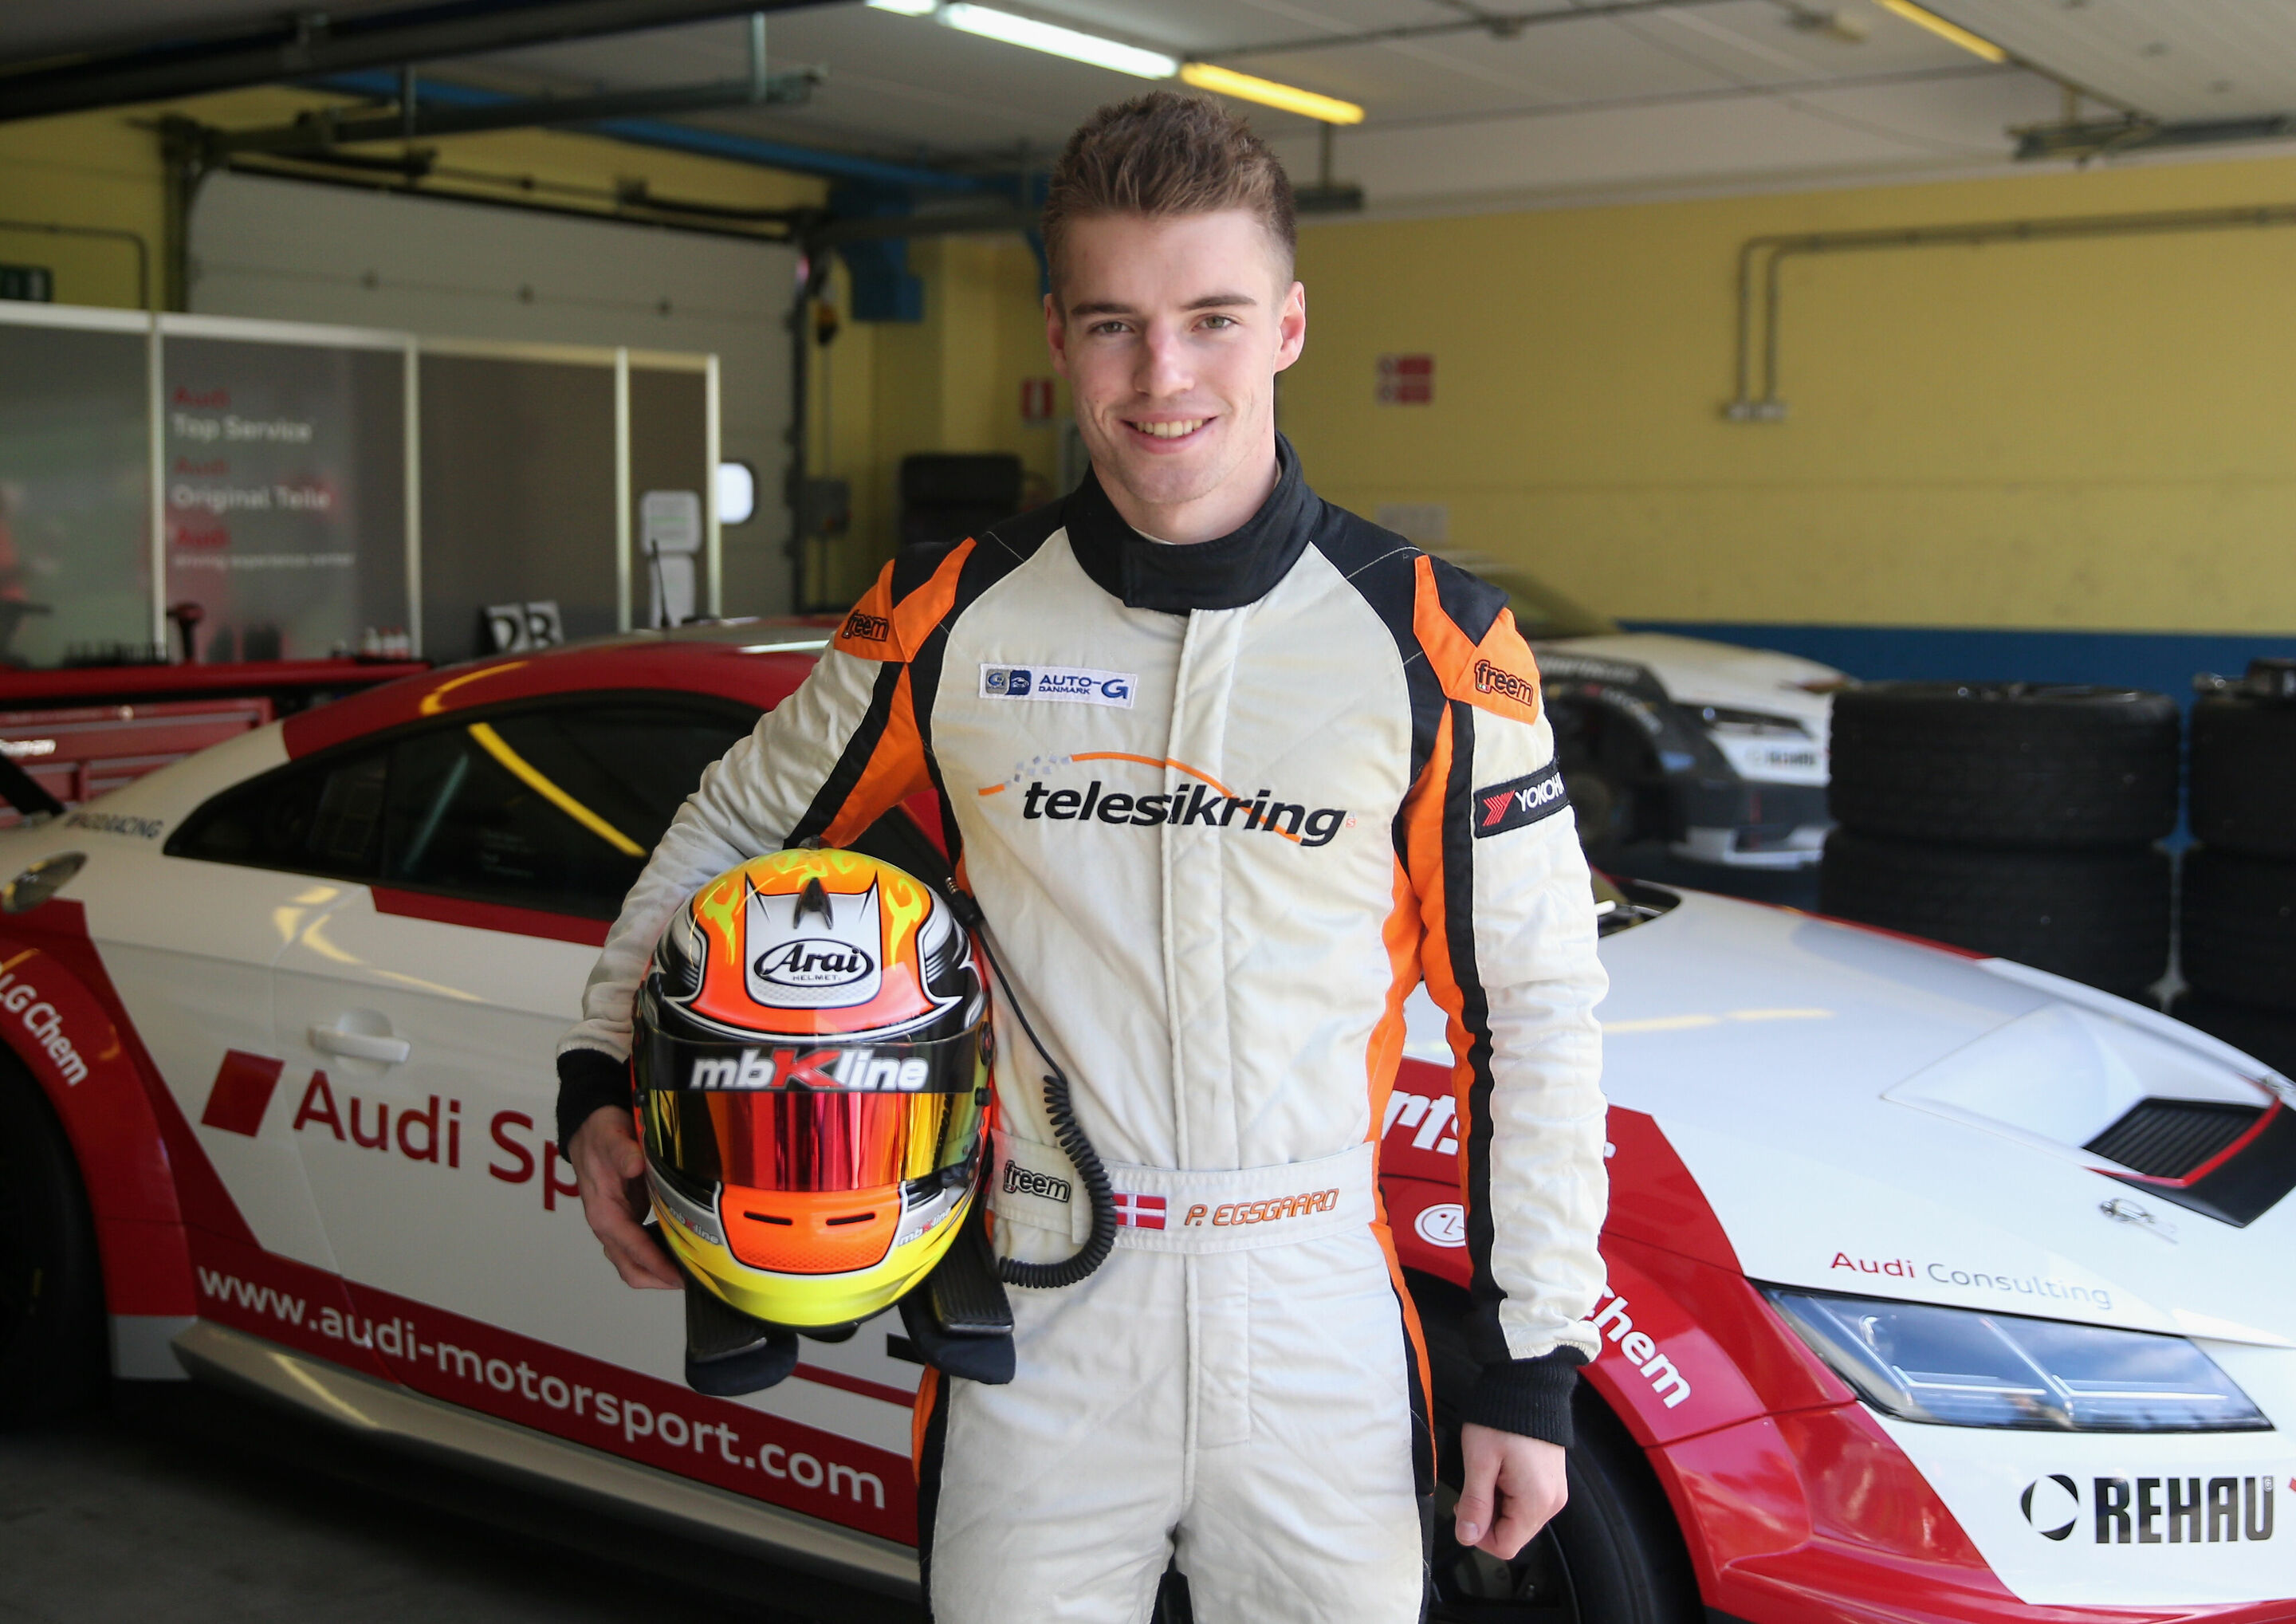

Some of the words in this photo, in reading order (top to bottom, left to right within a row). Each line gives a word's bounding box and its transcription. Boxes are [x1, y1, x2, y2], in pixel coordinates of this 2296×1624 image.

[171, 412, 221, 442] Top
[222, 413, 313, 443] Service
[171, 483, 269, 514] Original
[843, 610, 888, 641] freem
[1475, 660, 1533, 706] freem
[1023, 781, 1346, 847] telesikring
[762, 942, 861, 975] Arai
[22, 1001, 88, 1087] Chem
[689, 1048, 930, 1090] mbKline
[293, 1068, 461, 1169] Audi
[1004, 1159, 1071, 1202] freem
[1185, 1204, 1208, 1226] P.
[1830, 1252, 1915, 1278] Audi
[1927, 1263, 2113, 1310] Consulting
[197, 1264, 886, 1509] www.audi-motorsport.com
[2094, 1476, 2273, 1544] REHAU
